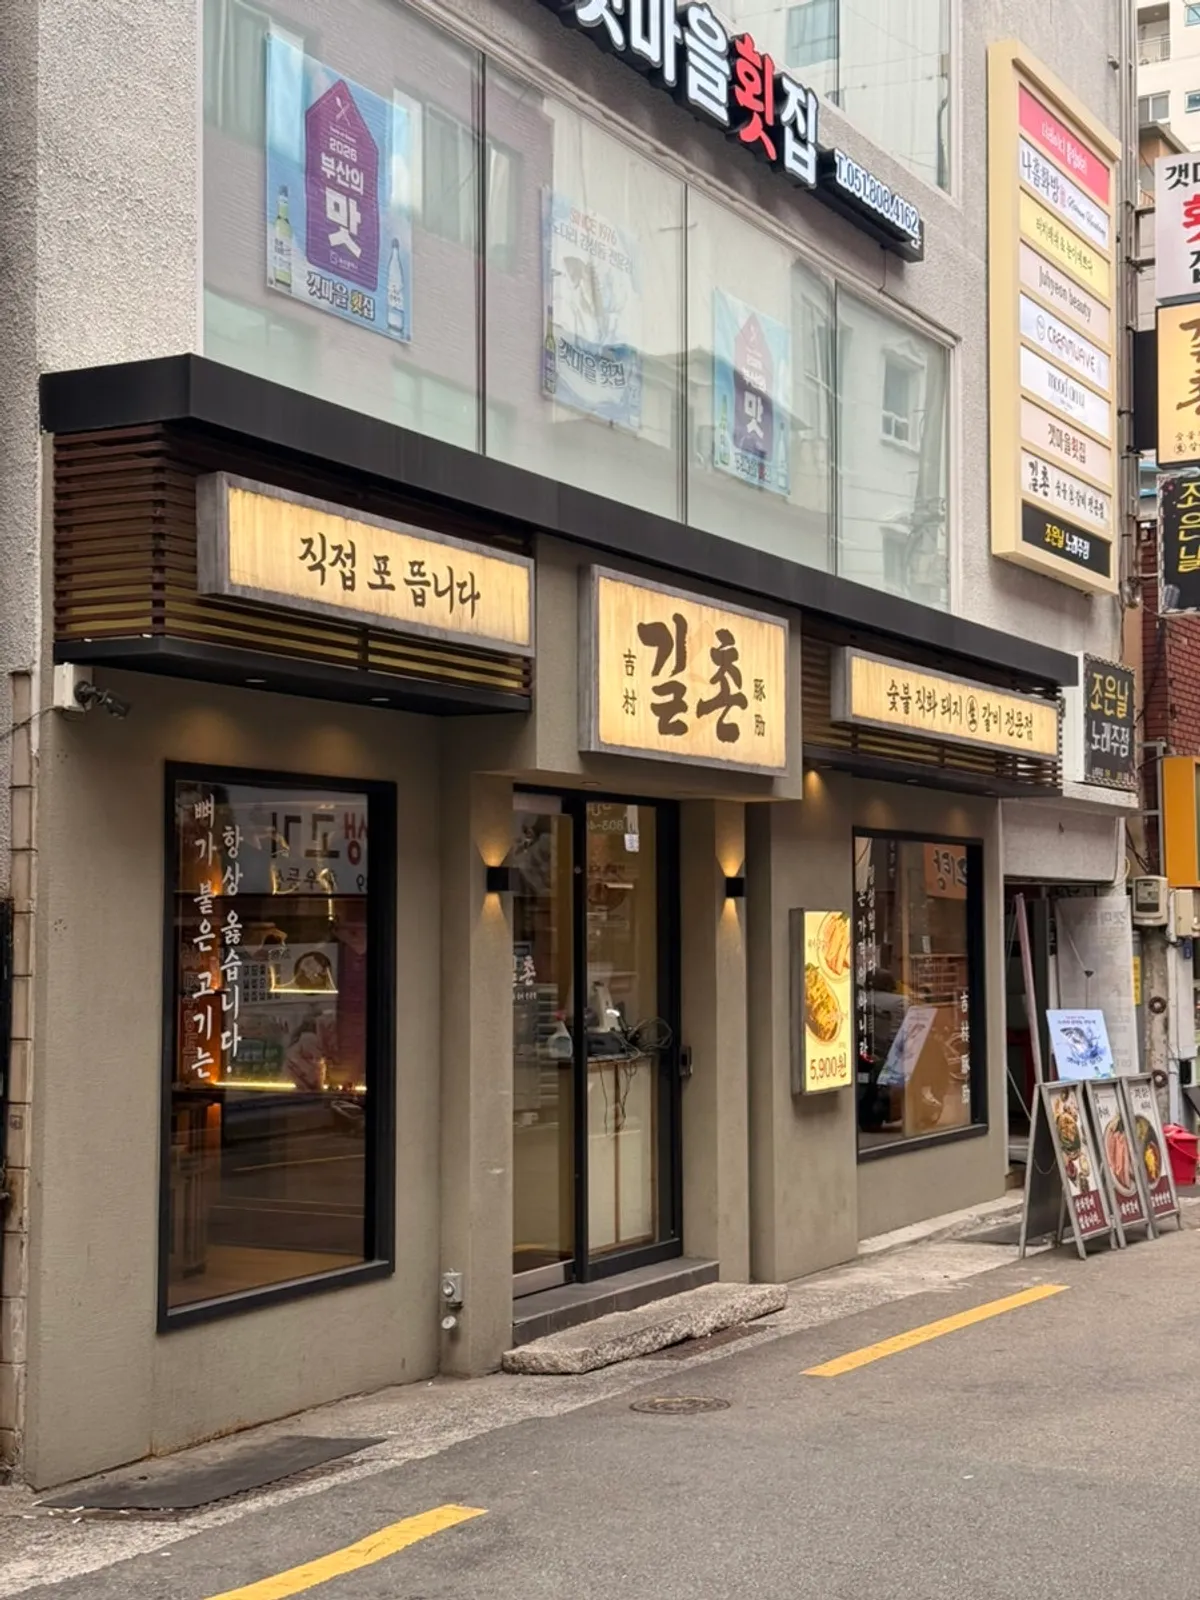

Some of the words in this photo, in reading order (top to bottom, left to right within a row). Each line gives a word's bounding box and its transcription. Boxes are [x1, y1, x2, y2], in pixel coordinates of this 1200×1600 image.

[321, 152, 364, 196] 부산의
[324, 187, 362, 259] 맛
[744, 390, 764, 439] 맛
[298, 532, 356, 592] 직접
[367, 554, 396, 592] 포
[403, 559, 481, 619] 뜹니다
[622, 647, 638, 716] 吉村
[636, 612, 749, 743] 길촌
[886, 679, 912, 715] 숯불
[915, 685, 939, 719] 직화
[940, 692, 963, 725] 돼지
[981, 701, 1001, 734] 갈비
[1004, 707, 1033, 742] 전문점
[1090, 672, 1129, 719] 조은날
[1090, 719, 1130, 758] 노래주점
[193, 794, 216, 866] 뼈가
[221, 825, 244, 897] 항상
[191, 971, 217, 1079] 고기는
[809, 1051, 848, 1082] 5,900원
